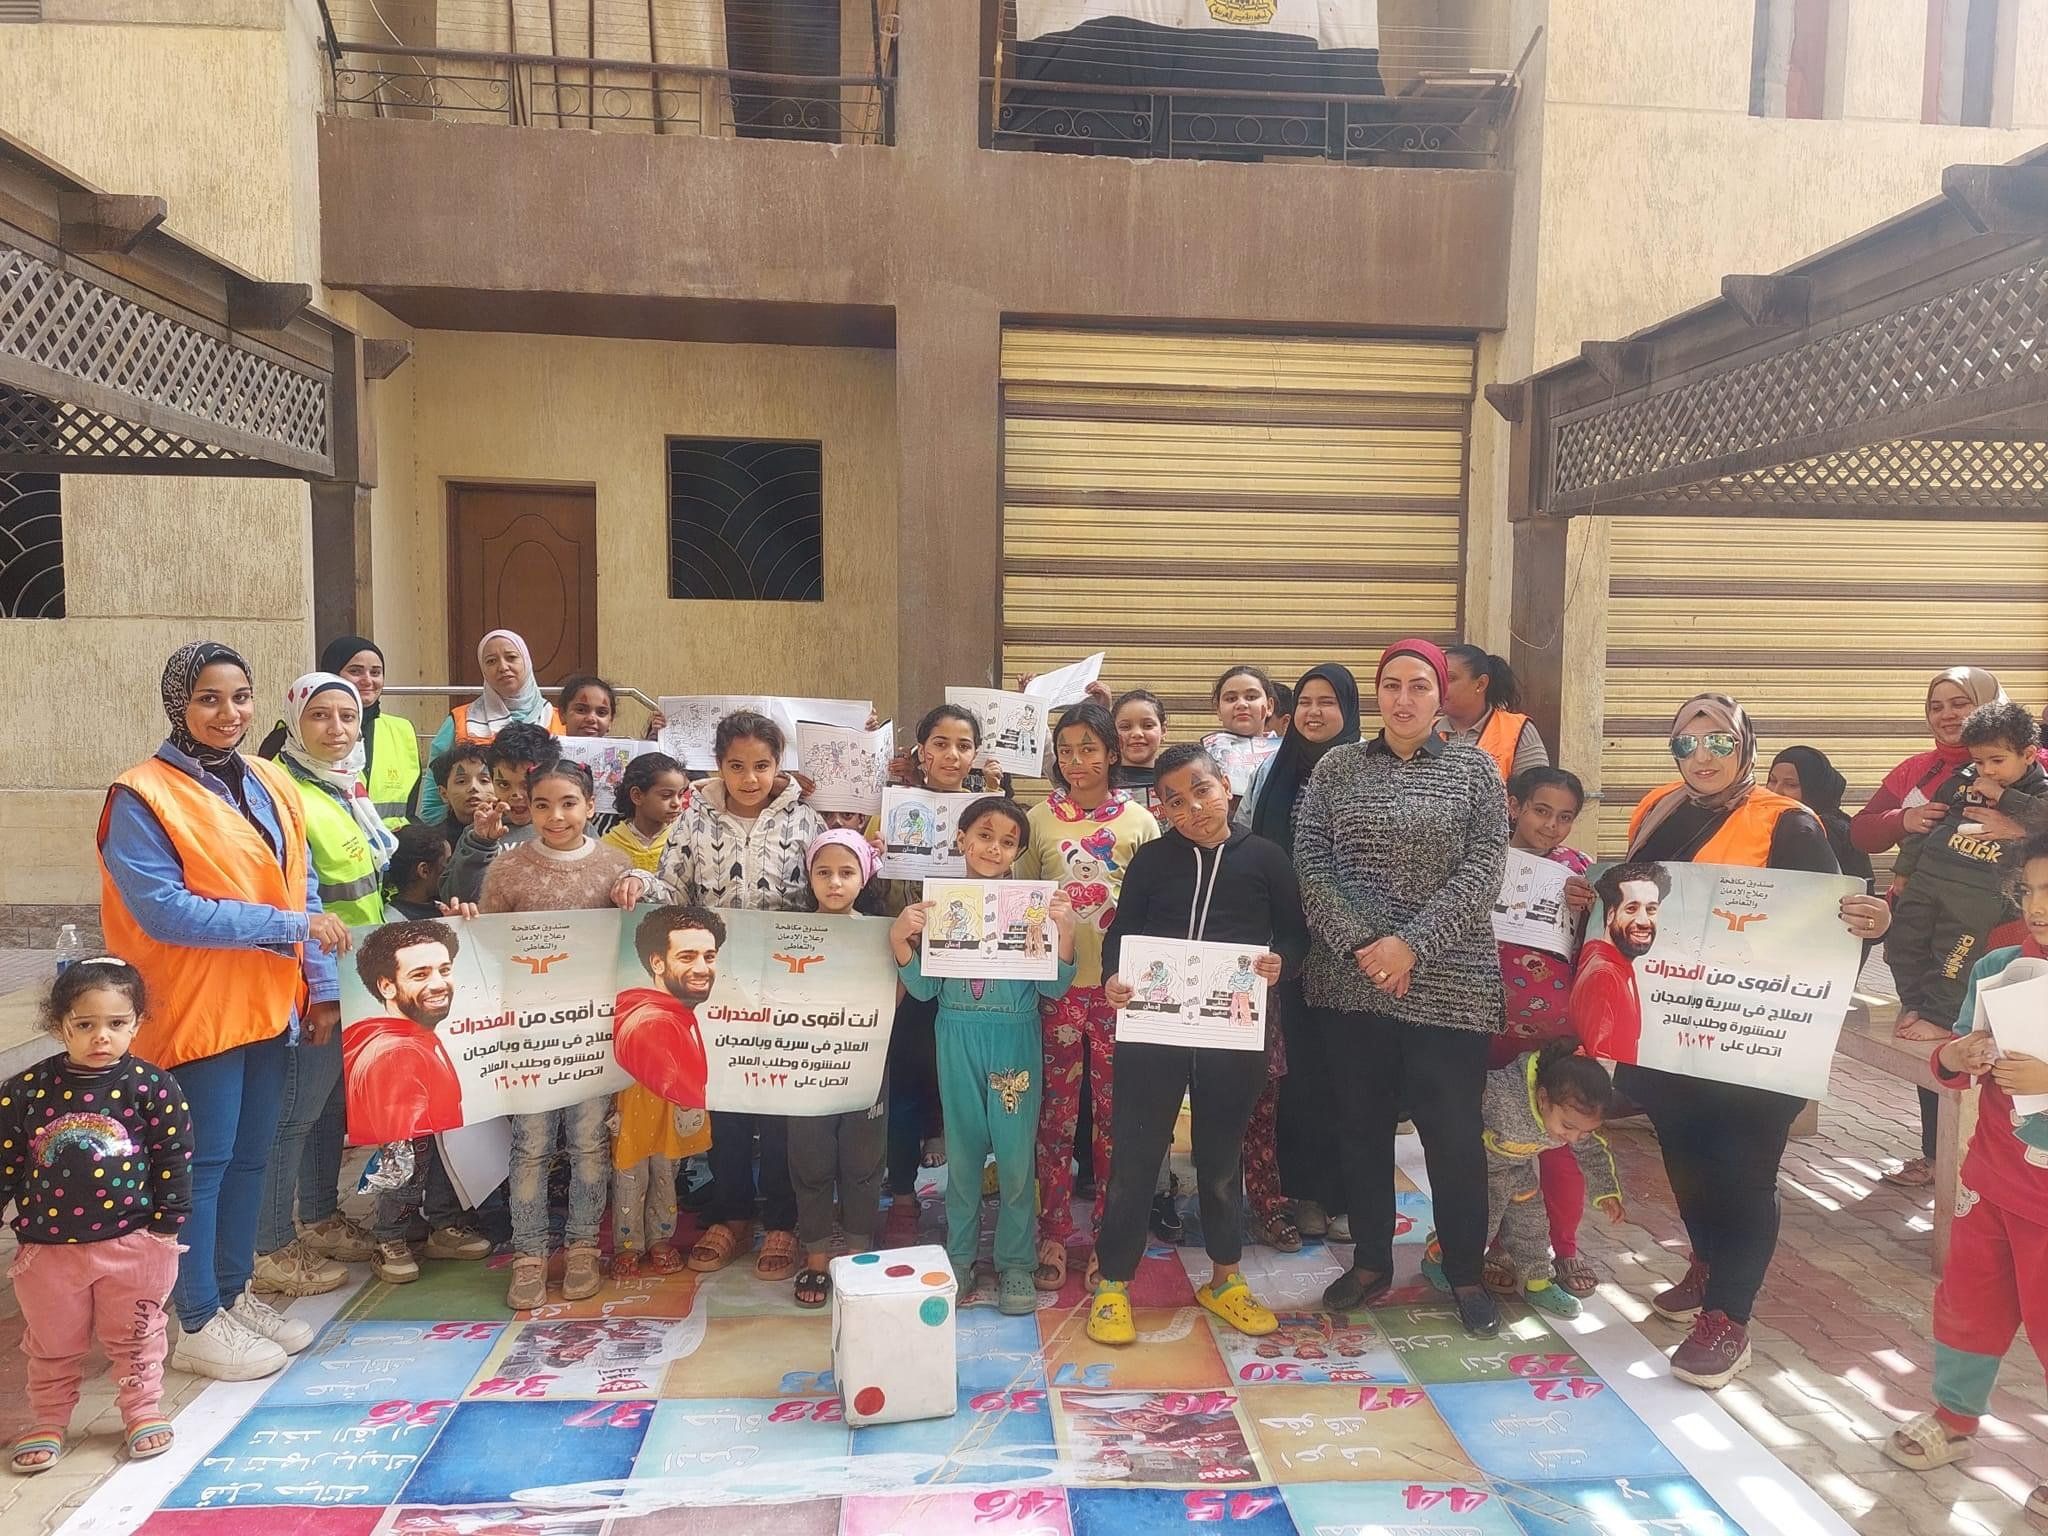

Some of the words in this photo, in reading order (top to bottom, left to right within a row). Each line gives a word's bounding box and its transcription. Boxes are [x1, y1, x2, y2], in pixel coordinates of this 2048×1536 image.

[1948, 833, 2003, 863] ROCK
[1719, 877, 1746, 885] مكافحة
[1746, 879, 1774, 888] صندوق
[511, 924, 540, 932] مكافحة
[541, 924, 570, 932] صندوق
[775, 923, 801, 931] مكافحة
[802, 925, 828, 933] صندوق
[1645, 959, 1705, 980] المخدرات
[1706, 969, 1735, 985] من
[1738, 974, 1790, 993] أقوى
[1790, 980, 1832, 1000] أنت
[550, 1000, 593, 1024] أقوى
[1705, 995, 1741, 1012] سرية
[449, 1011, 515, 1035] المخدرات
[518, 1009, 546, 1028] من
[707, 1005, 771, 1024] المخدرات
[773, 1009, 798, 1026] من
[802, 1007, 845, 1028] أقوى
[848, 1008, 878, 1028] أنت
[1692, 1017, 1727, 1032] وطلب
[1730, 1021, 1787, 1040] للمشورة
[463, 1041, 520, 1061] وبالمجان
[523, 1037, 559, 1051] سرية
[715, 1034, 771, 1050] وبالمجان
[774, 1037, 809, 1051] سرية
[833, 1040, 869, 1053] العلاج
[1746, 1041, 1782, 1057] اتصل
[479, 1059, 508, 1077] العلاج
[511, 1057, 550, 1070] وطلب
[553, 1051, 605, 1067] للمشورة
[728, 1054, 760, 1068] العلاج
[762, 1056, 799, 1069] وطلب
[801, 1058, 851, 1071] للمشورة
[573, 1066, 604, 1081] اتصل
[819, 1076, 849, 1088] اتصل
[423, 1321, 504, 1340] 35
[1239, 1362, 1304, 1382] 30
[1506, 1353, 1584, 1377] 29
[469, 1374, 560, 1397] 34
[1528, 1378, 1604, 1402] 42
[1163, 1391, 1238, 1414] 40
[360, 1400, 458, 1427] 36
[563, 1401, 656, 1428] 37
[974, 1490, 1064, 1524] 46
[1183, 1490, 1273, 1521] 45
[1401, 1485, 1489, 1514] 44
